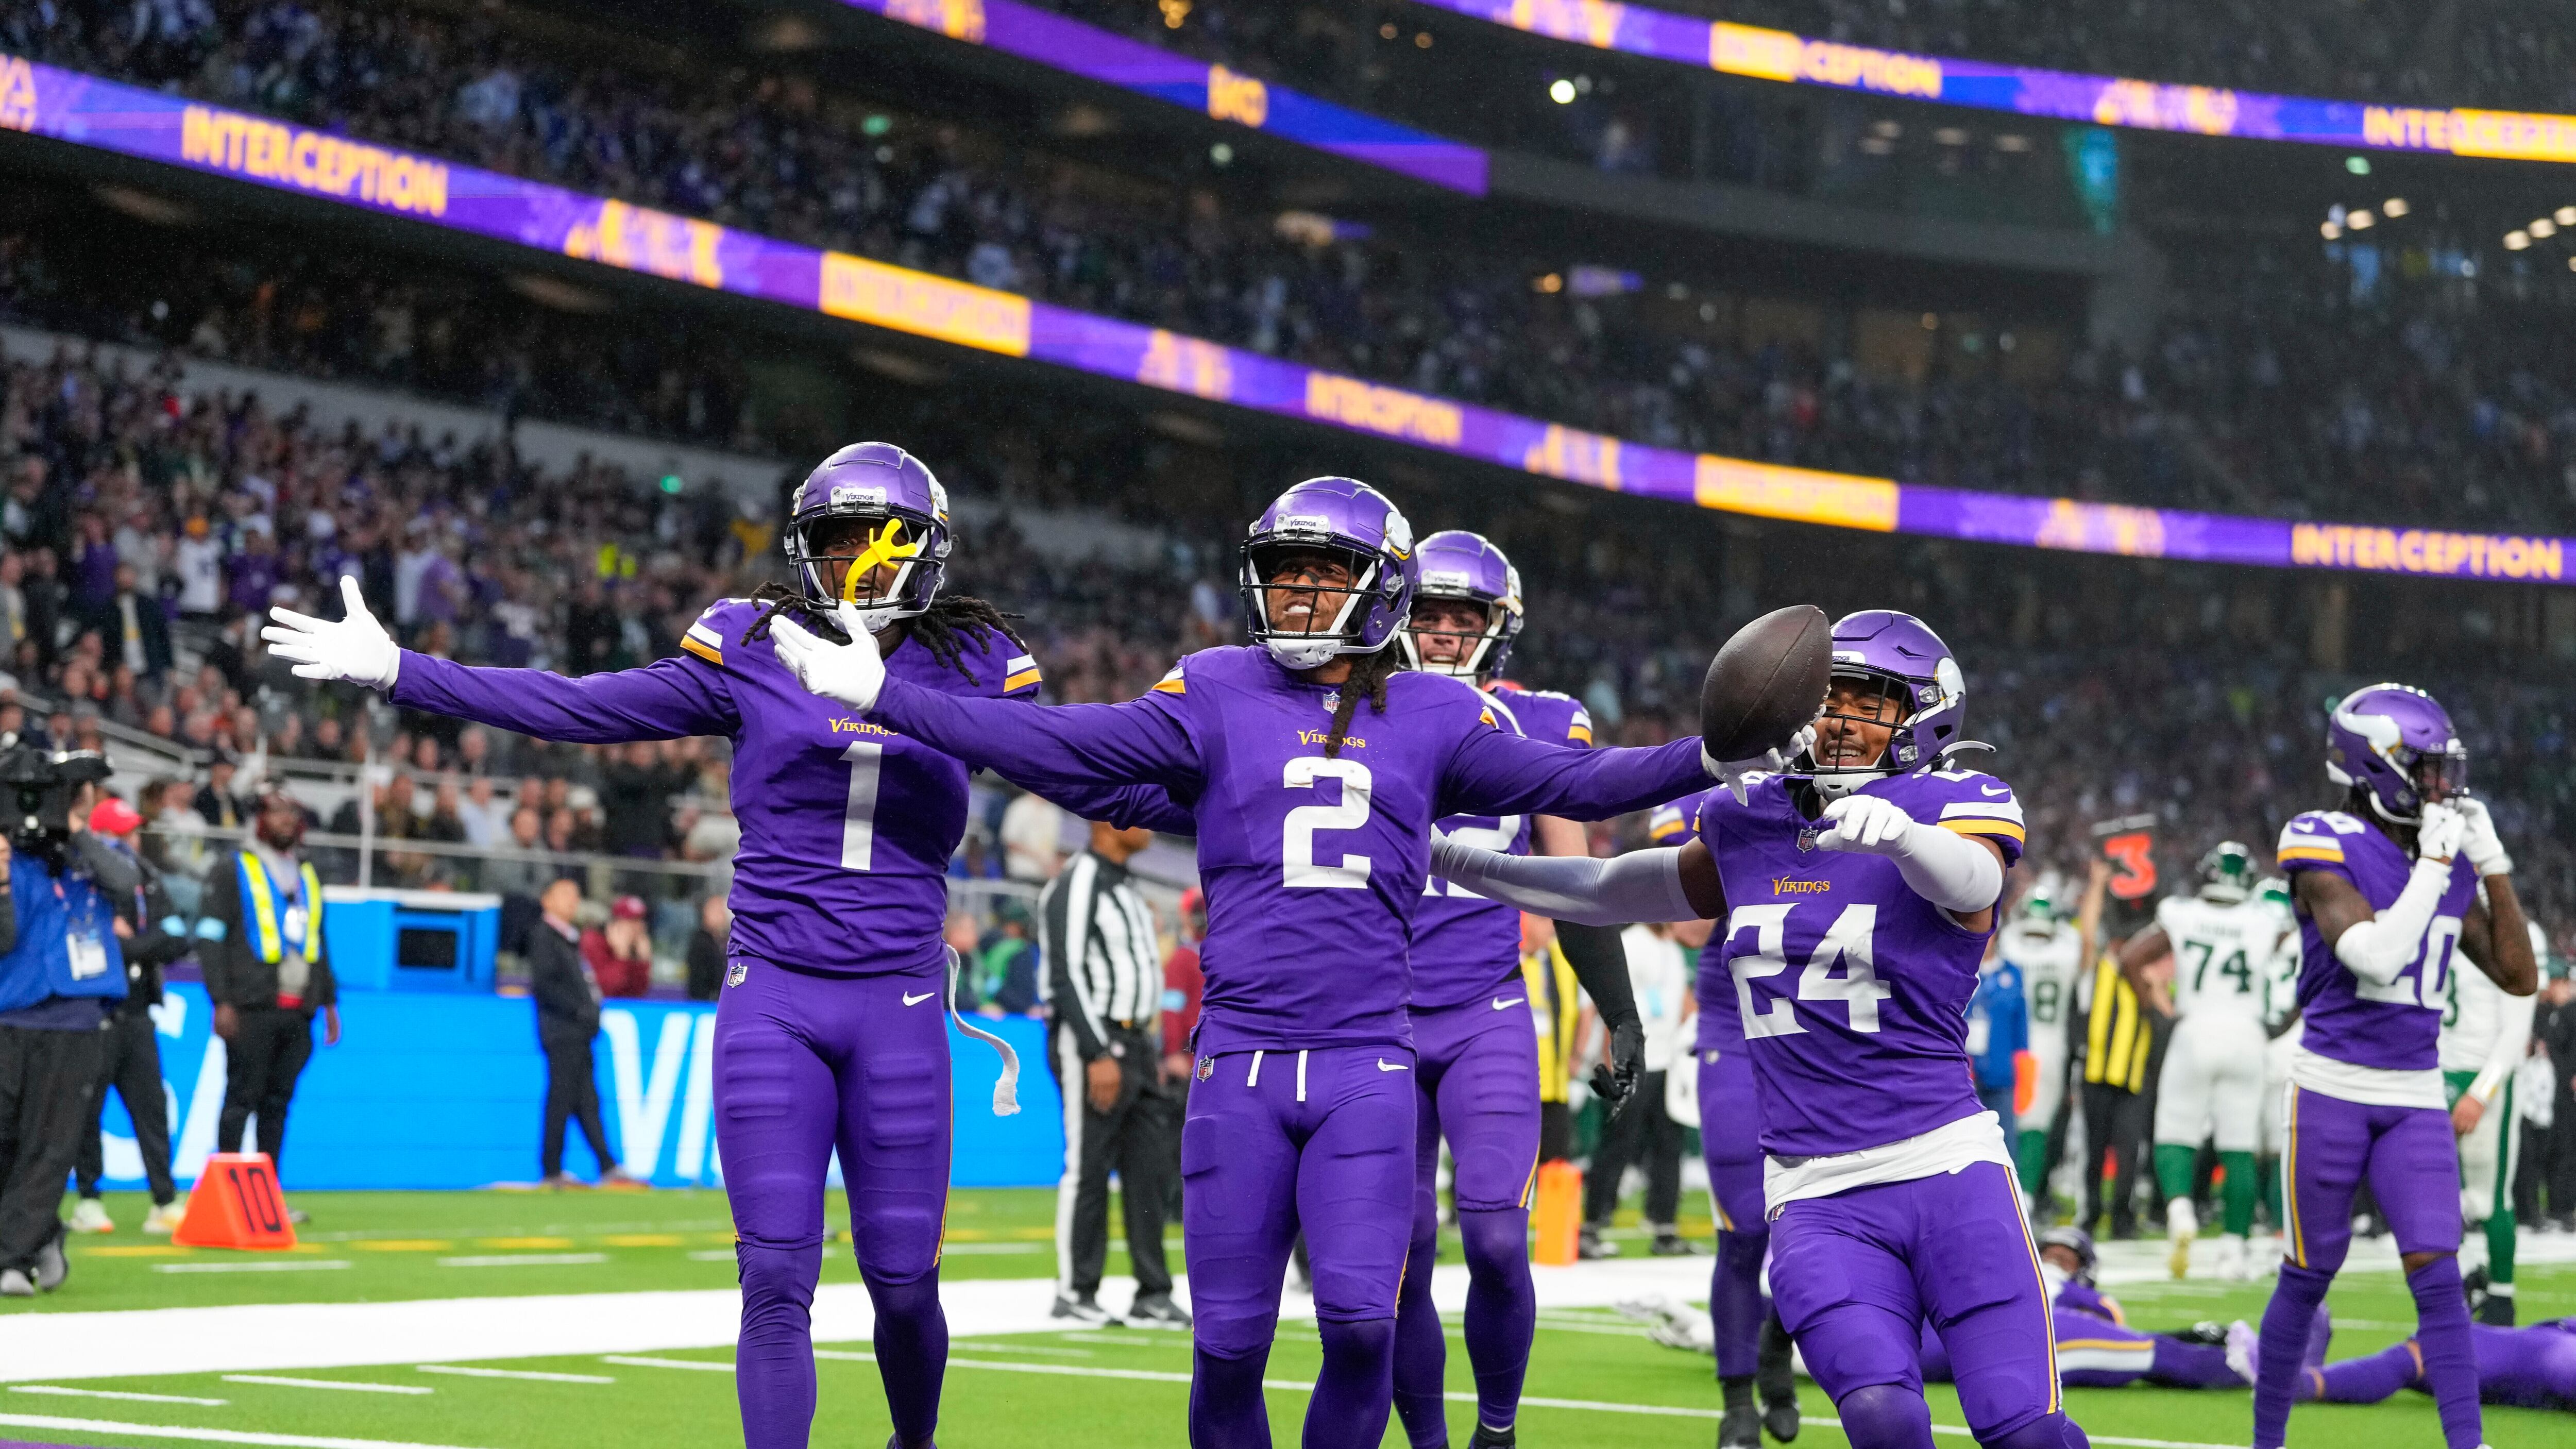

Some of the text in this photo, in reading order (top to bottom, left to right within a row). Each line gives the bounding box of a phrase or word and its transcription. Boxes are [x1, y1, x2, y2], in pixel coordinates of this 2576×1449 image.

[180, 105, 449, 218] INTERCEPTION
[2292, 523, 2564, 580] INTERCEPTION
[1297, 728, 1366, 749] VIKGS
[838, 740, 883, 871] 1
[1282, 756, 1372, 889] 2
[2104, 832, 2158, 899] 3
[1723, 903, 1891, 1040] 24
[2183, 938, 2252, 995] 74
[229, 1167, 282, 1232] 10
